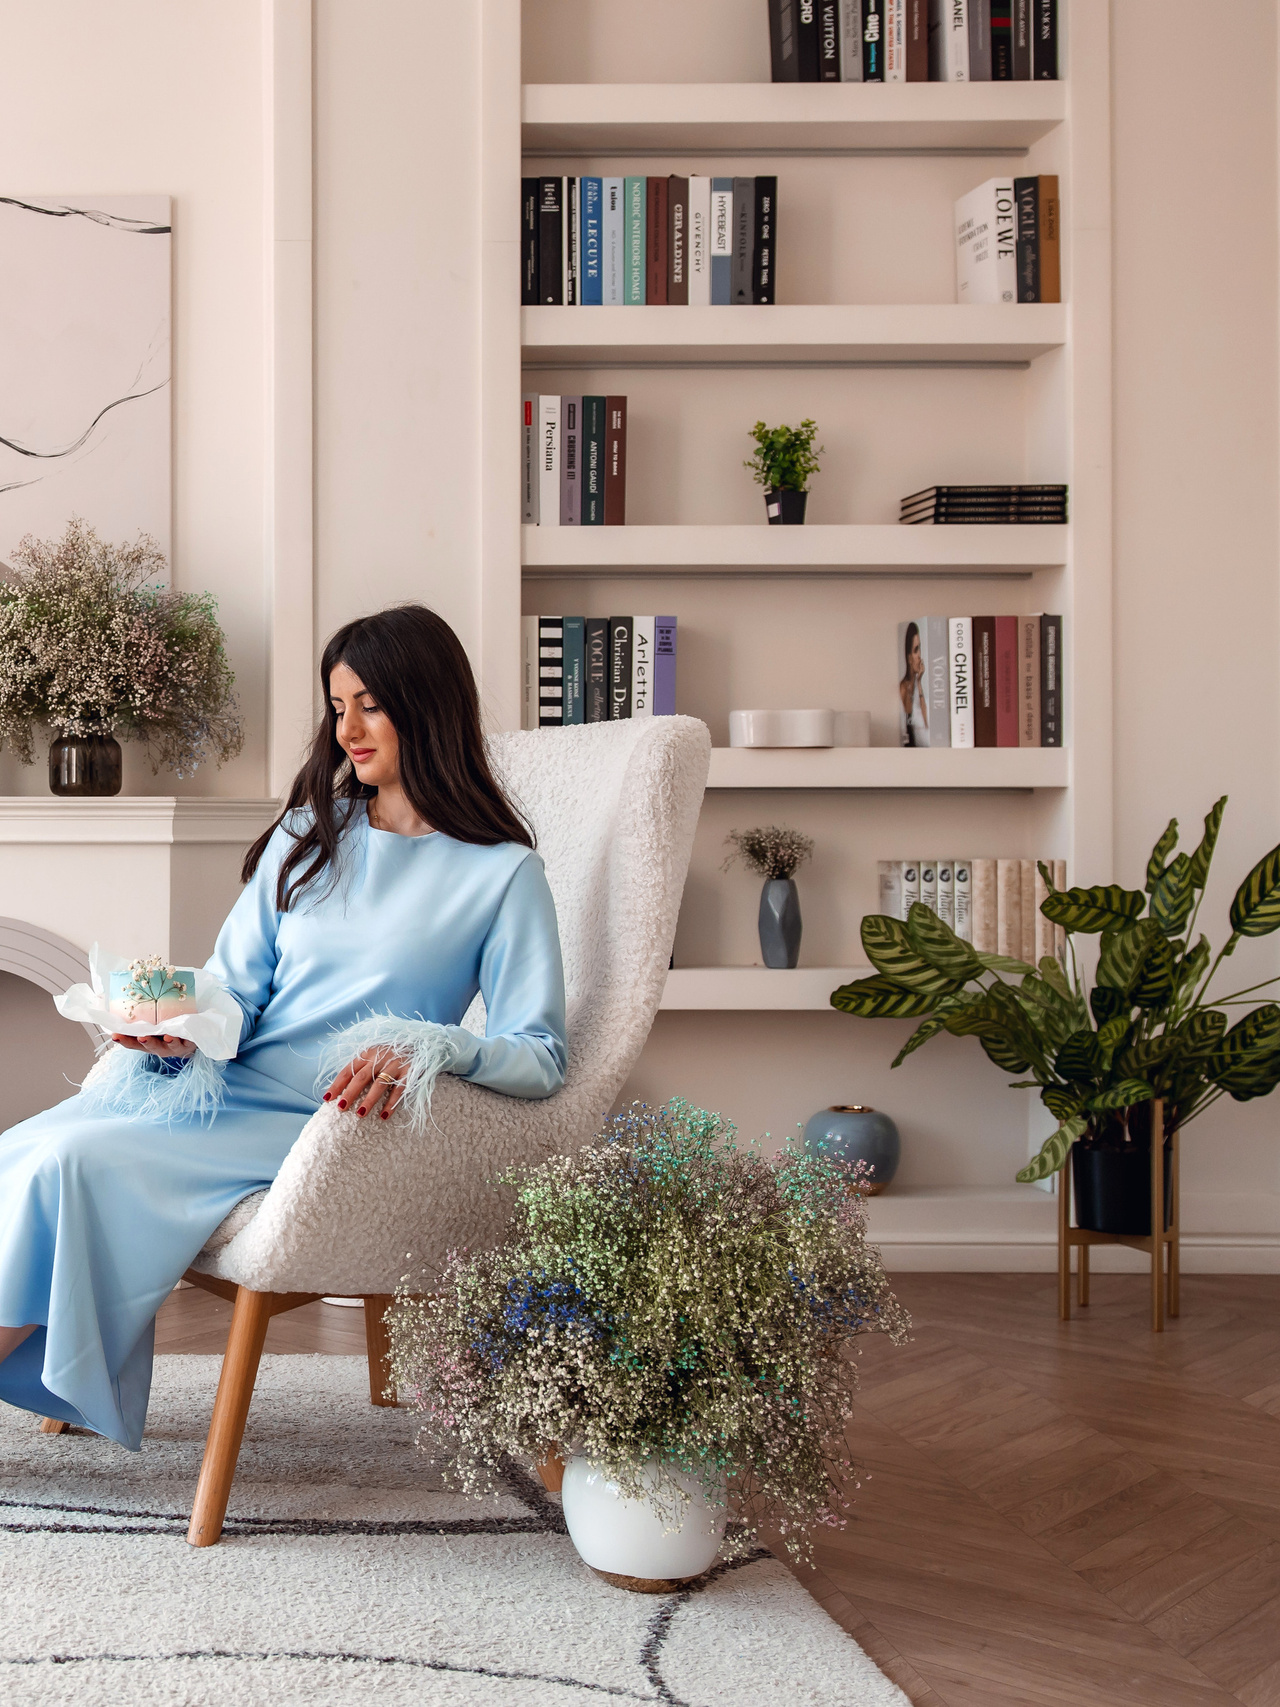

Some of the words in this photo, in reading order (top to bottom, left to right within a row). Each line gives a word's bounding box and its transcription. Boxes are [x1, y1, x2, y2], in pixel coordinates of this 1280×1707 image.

[824, 6, 835, 59] VUITTON
[633, 182, 641, 218] NORDIC
[717, 195, 726, 250] HYPEBEAST
[995, 187, 1014, 260] LOEWE
[1021, 187, 1035, 240] VOGUE
[632, 219, 640, 267] INTERIORS
[545, 421, 556, 471] Persiana
[567, 435, 576, 469] CRUSHING
[591, 629, 604, 683] VOGUE
[614, 626, 628, 683] Christian
[636, 634, 649, 709] Arletta
[614, 687, 627, 720] Dior
[932, 656, 945, 710] VOGUE
[955, 653, 968, 714] CHANEL
